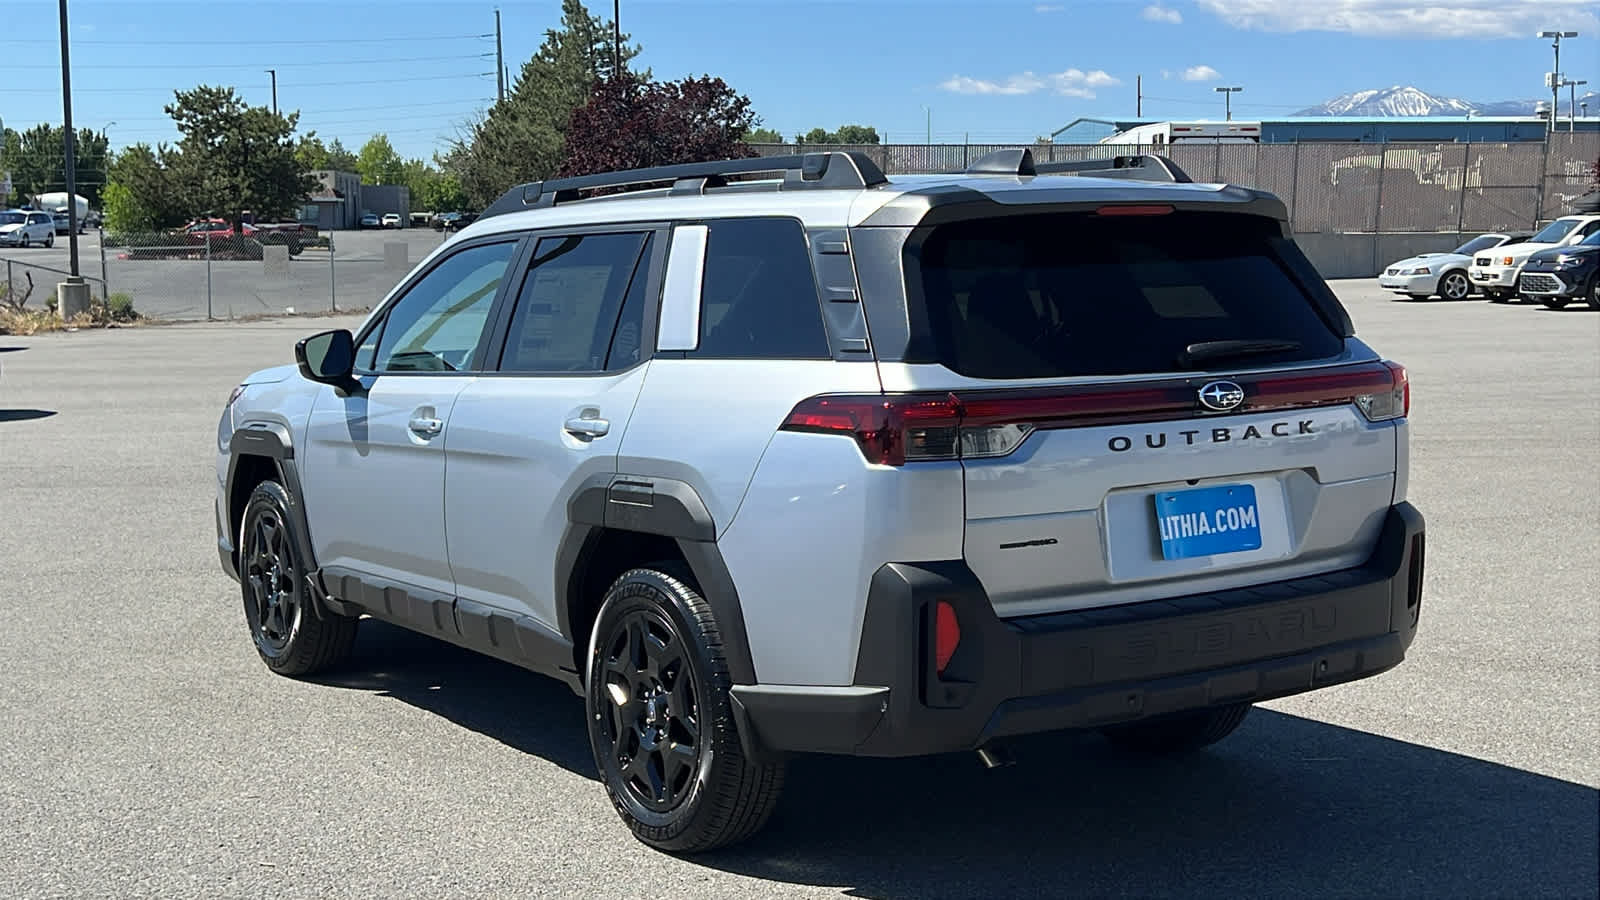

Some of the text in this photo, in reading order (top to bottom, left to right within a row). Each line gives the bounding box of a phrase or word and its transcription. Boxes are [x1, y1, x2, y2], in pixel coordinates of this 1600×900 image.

[1108, 420, 1314, 451] OUTBACK
[1160, 505, 1257, 541] LITHIA.COM
[1119, 606, 1337, 664] SUBARU
